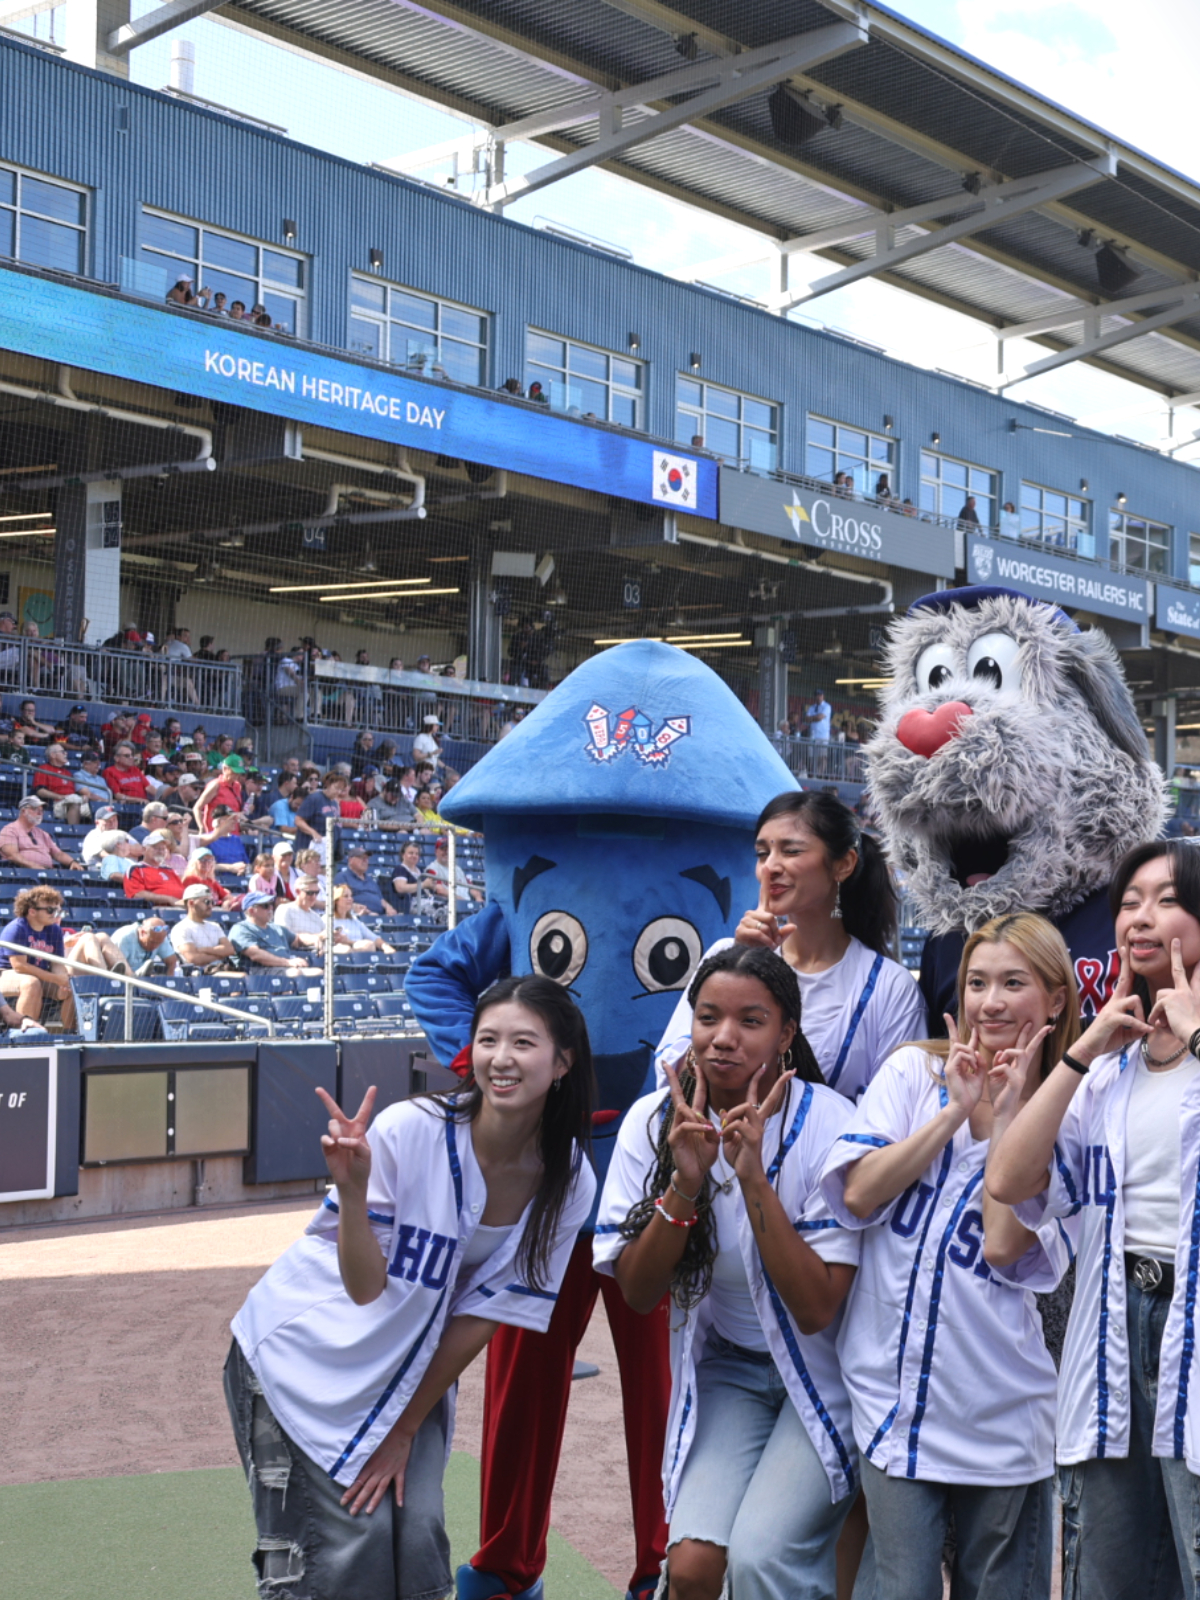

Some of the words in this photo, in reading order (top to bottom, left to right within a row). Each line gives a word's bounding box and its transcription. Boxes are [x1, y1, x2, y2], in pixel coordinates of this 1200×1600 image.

[204, 350, 296, 393] KOREAN
[302, 375, 401, 420] HERITAGE
[406, 402, 446, 430] DAY
[624, 583, 641, 604] 03
[996, 556, 1075, 593] WORCESTER
[1077, 578, 1127, 606] RAILERS
[1128, 590, 1143, 611] HC
[8, 1092, 27, 1108] OF
[387, 1224, 458, 1291] HU
